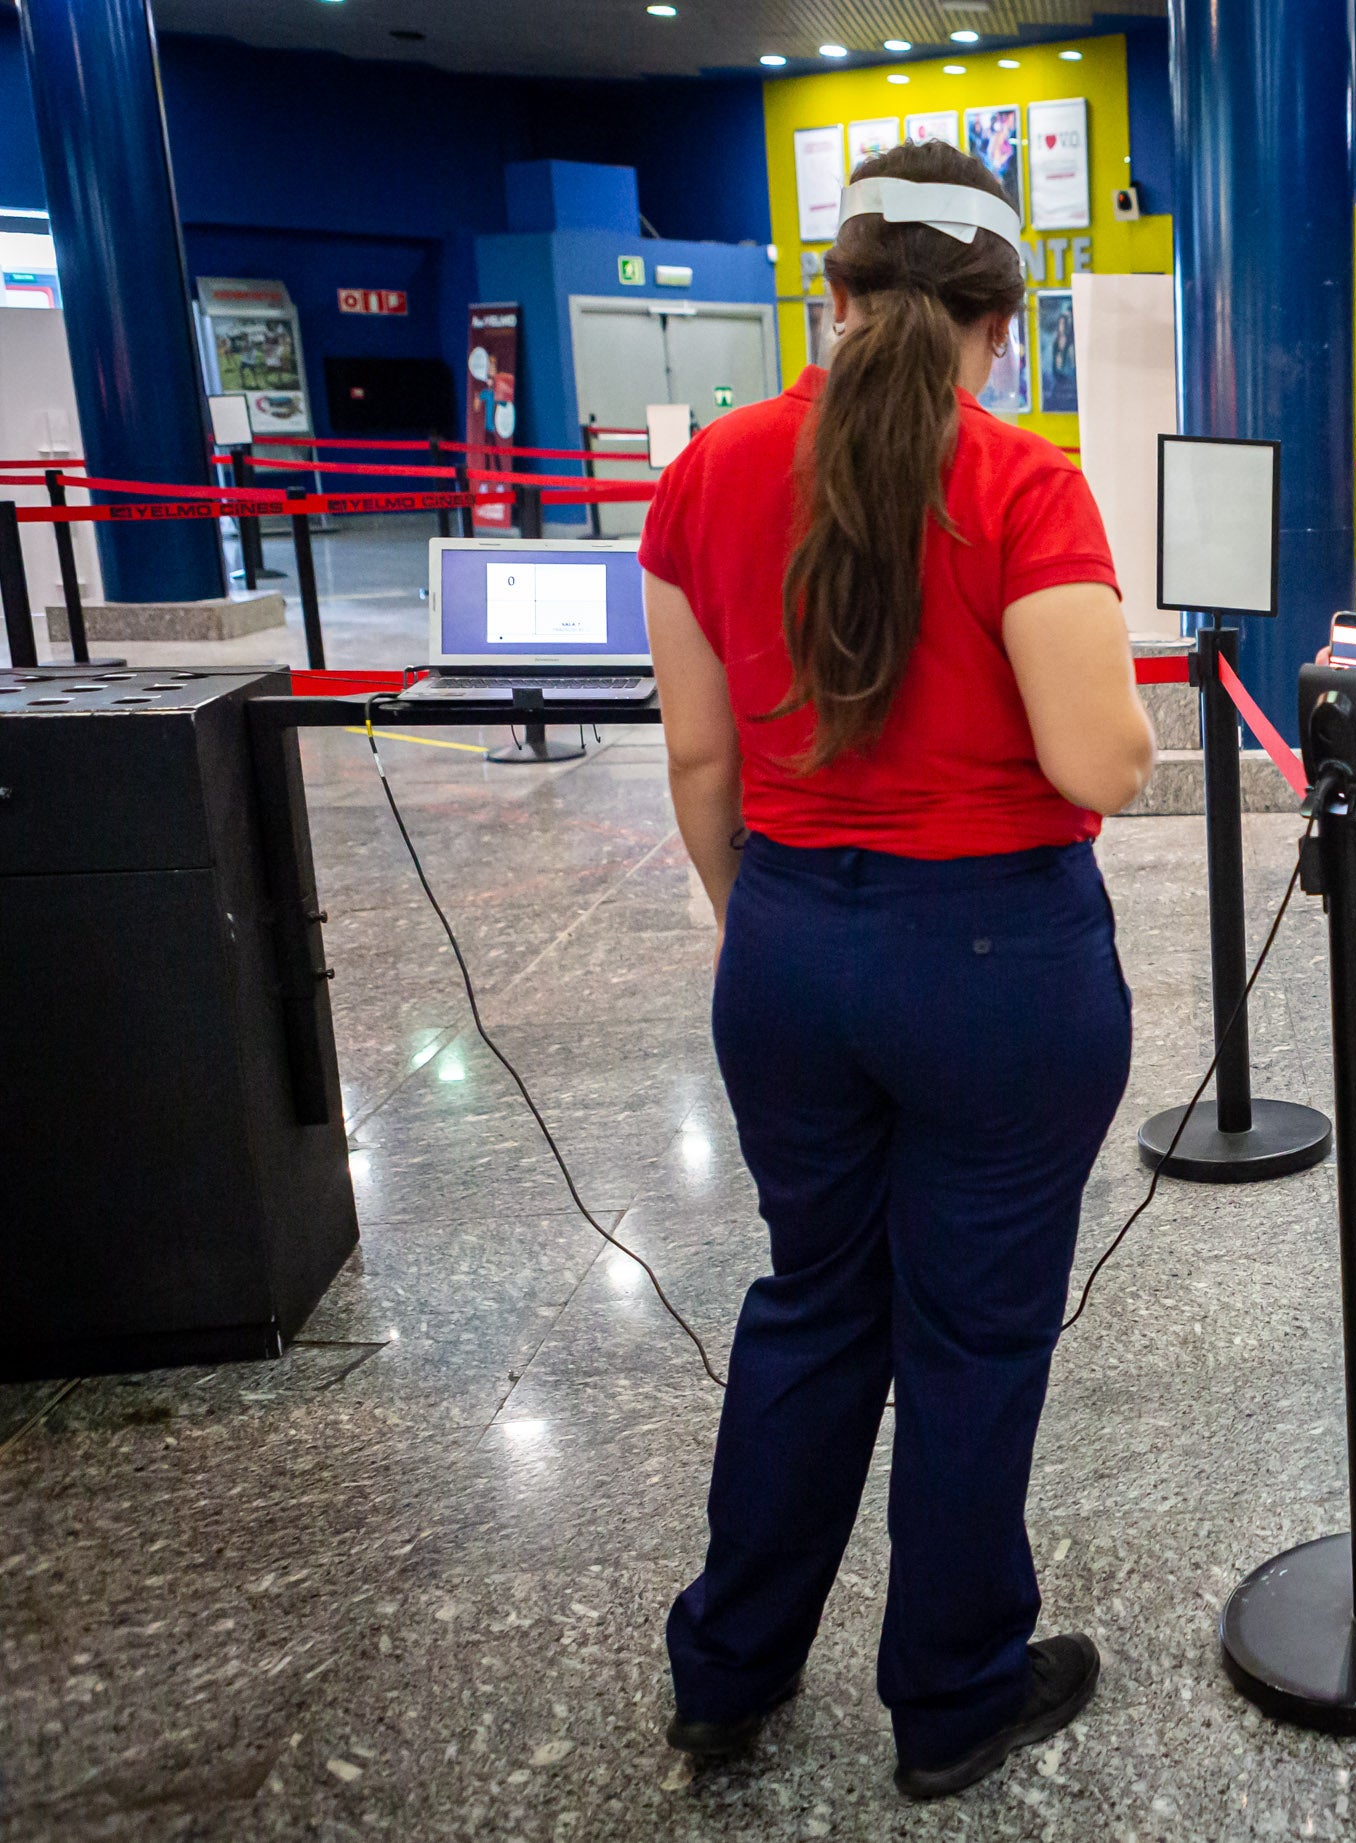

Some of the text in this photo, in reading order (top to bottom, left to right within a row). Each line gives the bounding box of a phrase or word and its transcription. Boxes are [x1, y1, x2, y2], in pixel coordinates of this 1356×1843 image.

[136, 502, 284, 519] YELMO CINES
[350, 497, 415, 511] YELMO
[507, 576, 515, 586] 0
